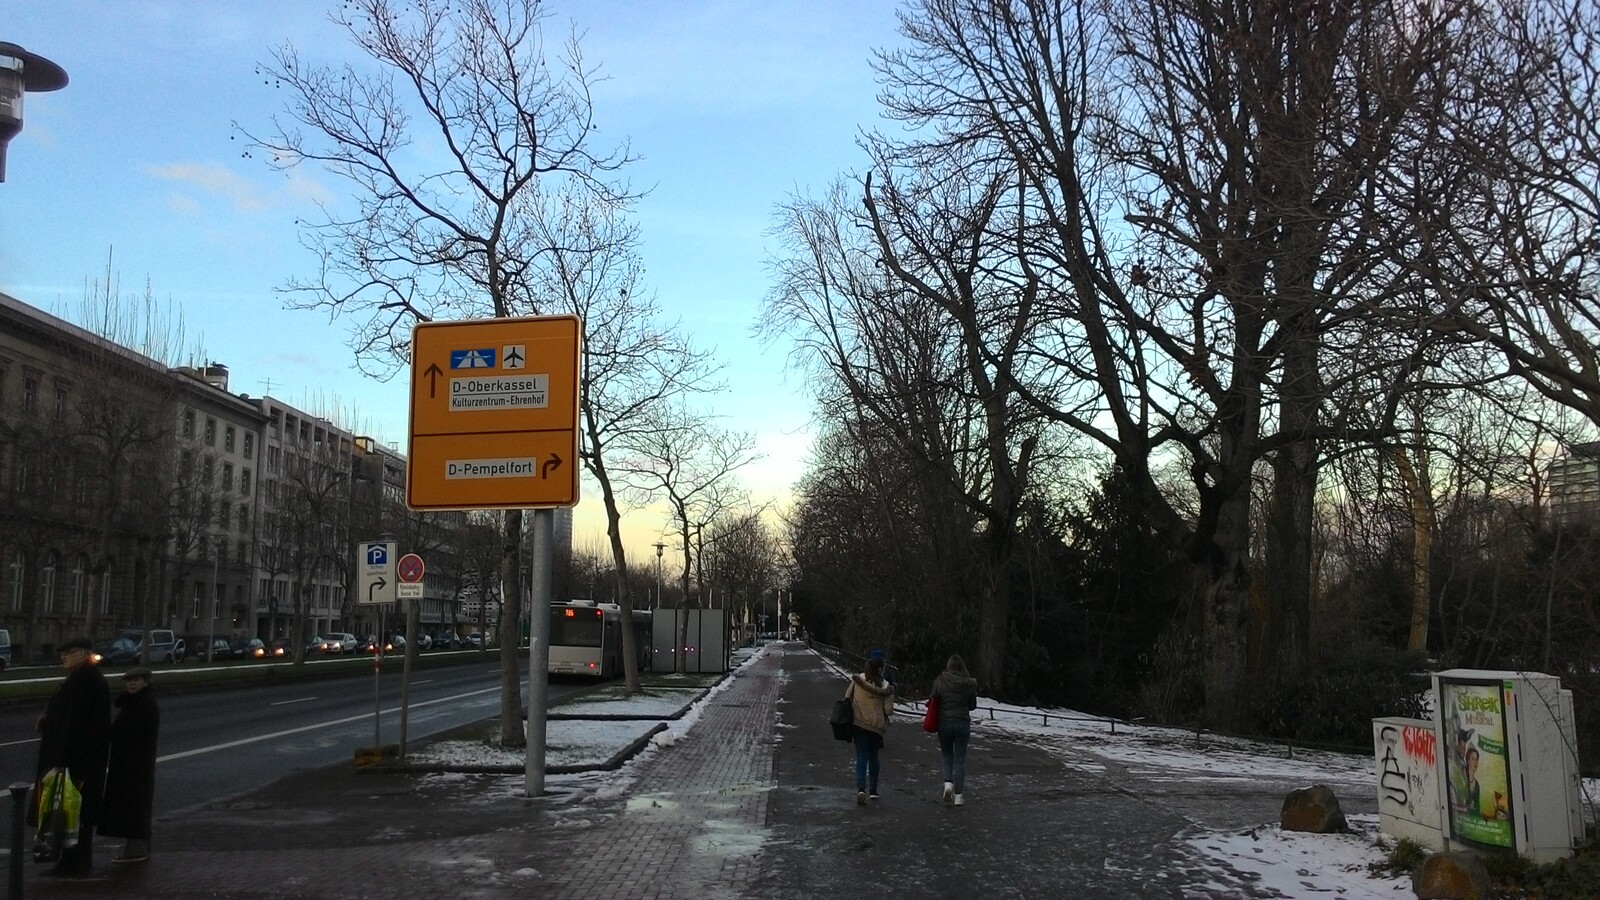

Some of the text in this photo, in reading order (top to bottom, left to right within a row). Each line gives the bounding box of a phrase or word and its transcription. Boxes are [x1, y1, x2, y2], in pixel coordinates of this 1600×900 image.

[452, 378, 537, 393] D-Oberkassel
[452, 394, 545, 408] Kulturzentrum-Ehrenhof
[448, 462, 532, 477] D-Pempelfort
